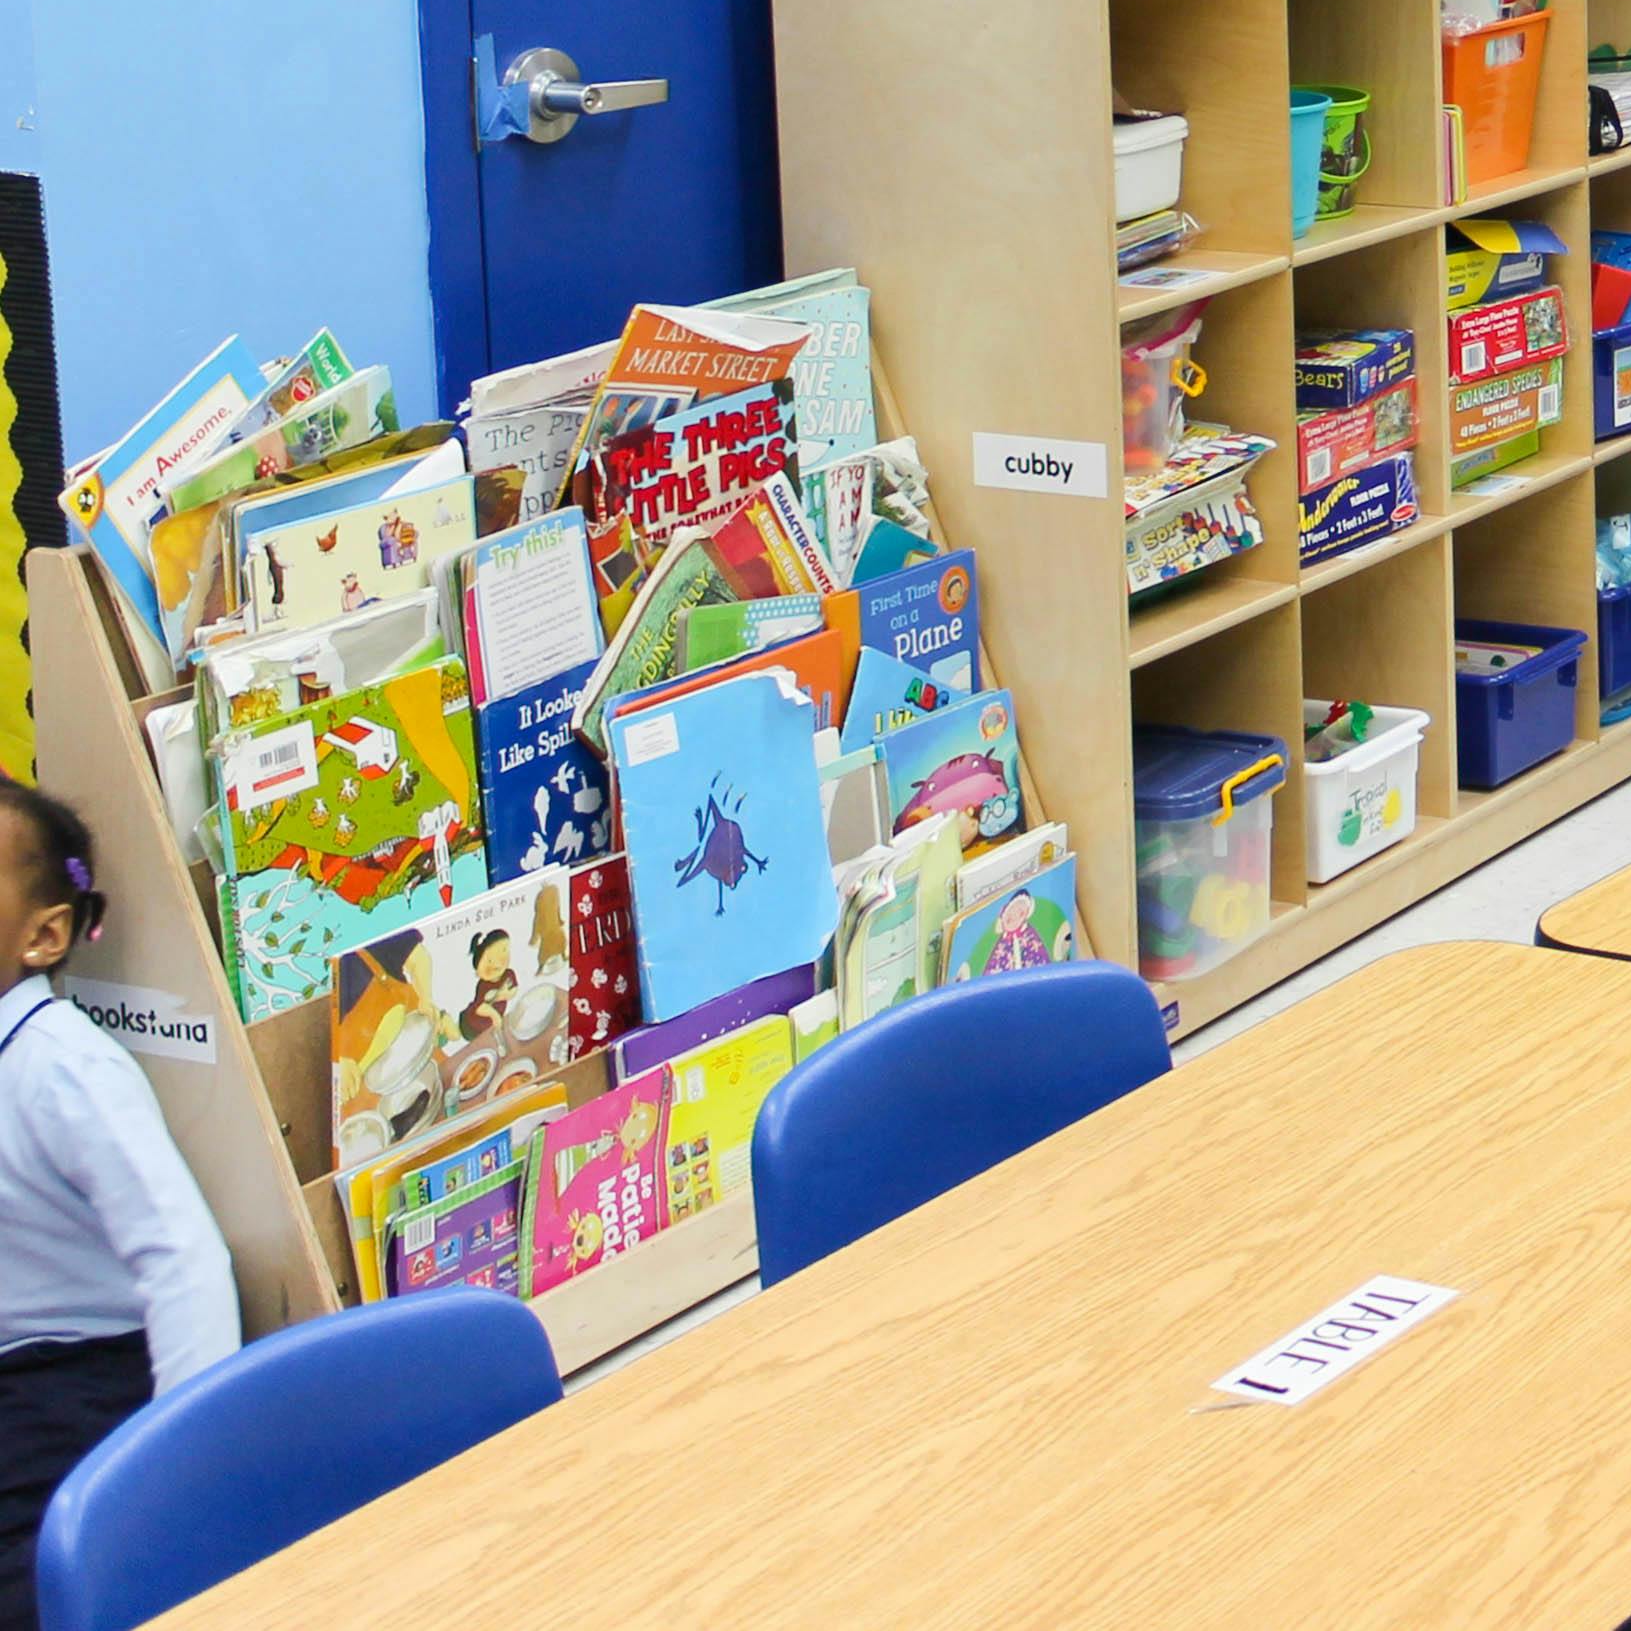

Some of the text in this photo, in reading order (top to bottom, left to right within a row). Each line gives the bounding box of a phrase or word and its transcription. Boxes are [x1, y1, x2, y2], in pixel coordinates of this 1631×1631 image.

[314, 340, 345, 385] World
[626, 348, 779, 382] MARKET STREET
[1295, 369, 1345, 390] Bears
[1456, 369, 1542, 412] ENDANGERED SPECIES
[804, 399, 866, 437] SAM
[485, 423, 536, 453] The
[609, 397, 783, 486] THE THREE
[719, 437, 788, 493] PIGS
[1004, 450, 1073, 484] cubby
[135, 473, 157, 500] am
[1341, 515, 1358, 532] Feet
[490, 520, 565, 570] Try this!
[1151, 527, 1211, 567] Shape
[870, 579, 938, 617] First Time
[890, 610, 919, 630] on a
[630, 629, 656, 661] THE
[894, 619, 964, 662] Plane
[519, 703, 533, 730] It
[498, 745, 534, 773] Like
[436, 894, 527, 939] LINDA SUE PARK
[1234, 1291, 1432, 1395] TABLE 1
